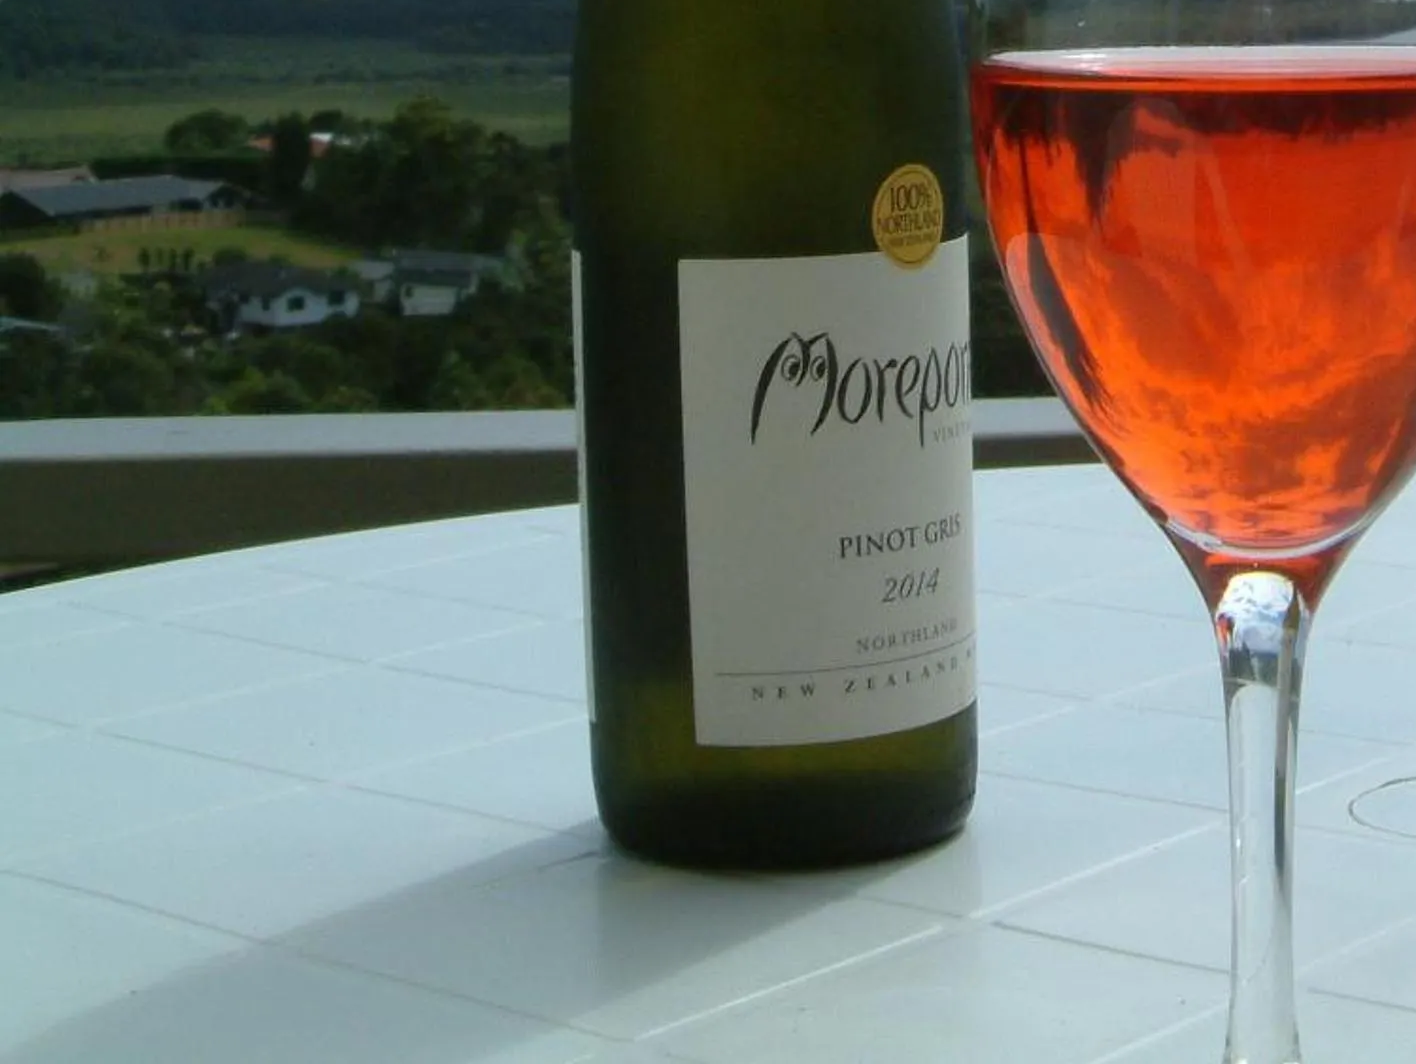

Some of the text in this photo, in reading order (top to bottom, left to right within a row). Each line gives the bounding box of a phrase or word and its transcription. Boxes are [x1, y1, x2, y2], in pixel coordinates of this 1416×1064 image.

[839, 513, 961, 559] PINOT GRIS
[882, 568, 940, 603] 2014
[856, 619, 957, 653] NORTHLAND
[752, 657, 958, 701] NEW ZEALAND
